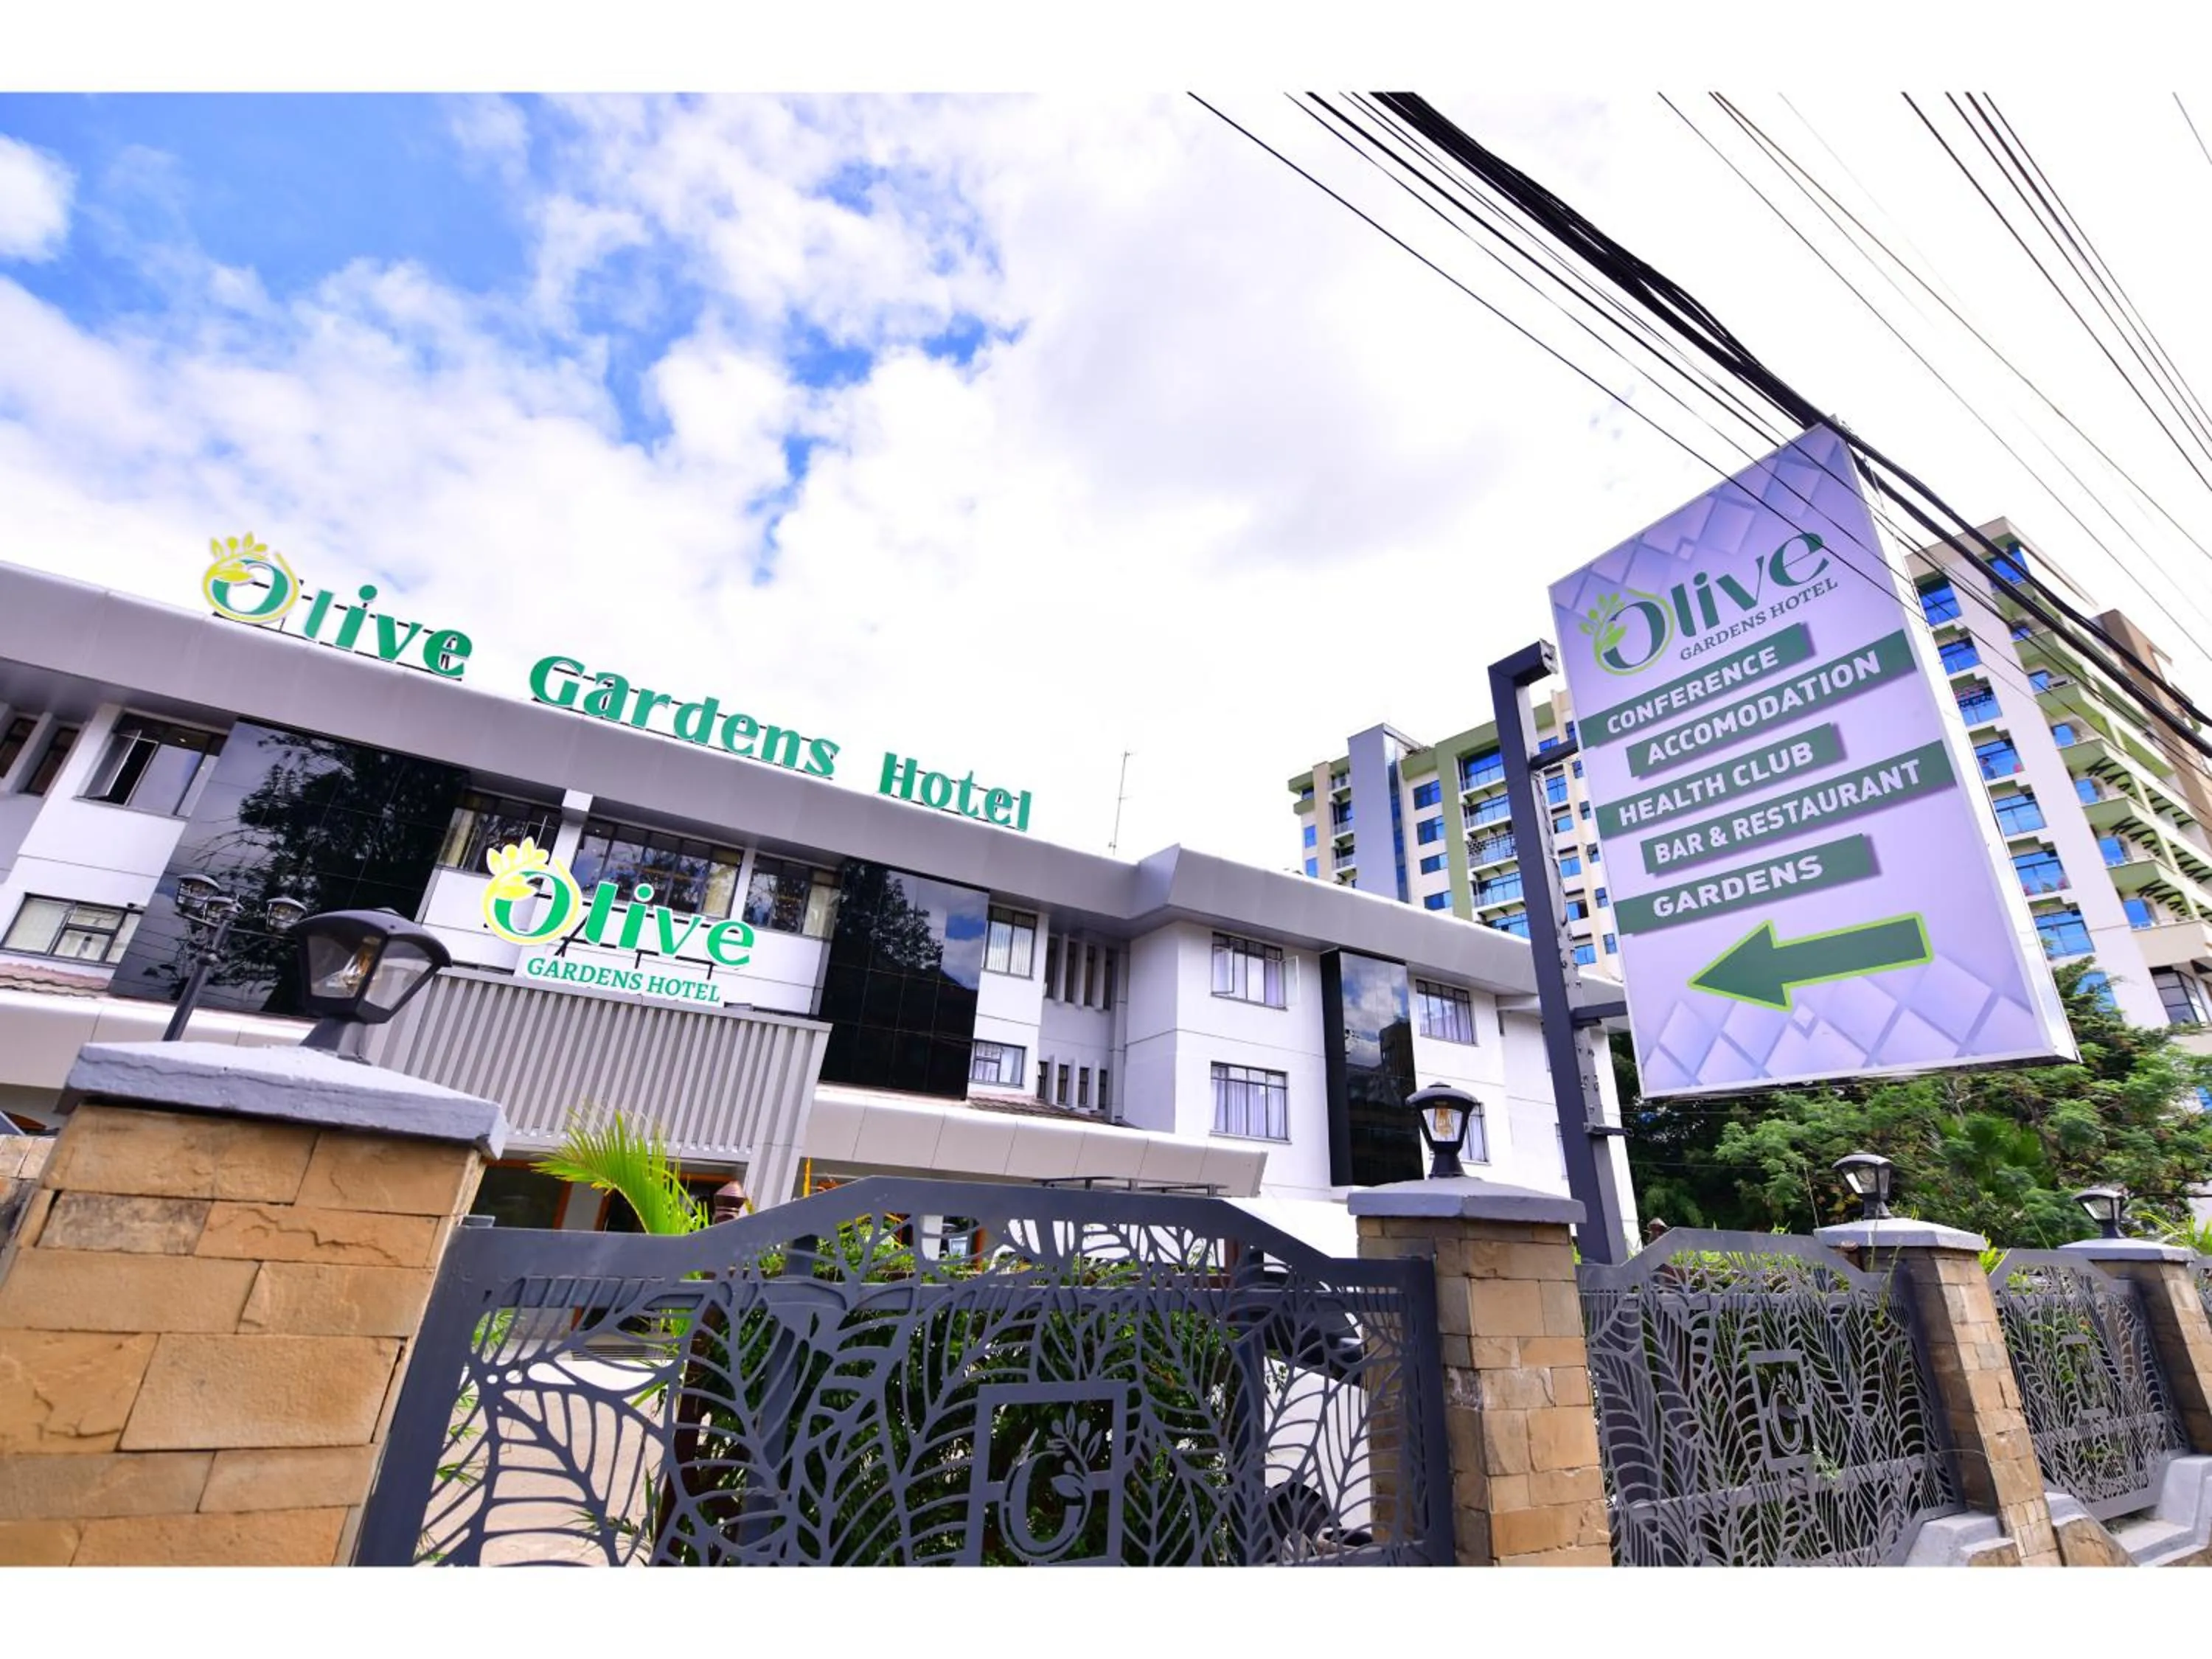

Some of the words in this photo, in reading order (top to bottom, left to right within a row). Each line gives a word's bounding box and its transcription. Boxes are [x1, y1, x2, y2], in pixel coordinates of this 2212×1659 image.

[1580, 532, 1829, 675] Olive
[1680, 612, 1767, 661] GARDENS
[1770, 577, 1838, 619] HOTEL
[204, 542, 473, 676] Olive
[529, 655, 841, 778] Gardens
[879, 753, 1032, 832] Hotel
[1607, 647, 1779, 734] CONFERENCE
[1647, 650, 1881, 765] ACCOMODATION
[1619, 771, 1725, 827] HEALTH
[1733, 742, 1814, 788] CLUB
[1654, 831, 1704, 866] BAR
[1710, 826, 1728, 848] &
[1733, 759, 1920, 838] RESTAURANT
[482, 848, 754, 966] Olive
[1652, 855, 1823, 918] GARDENS
[526, 958, 644, 991] GARDENS
[647, 976, 721, 1004] HOTEL
